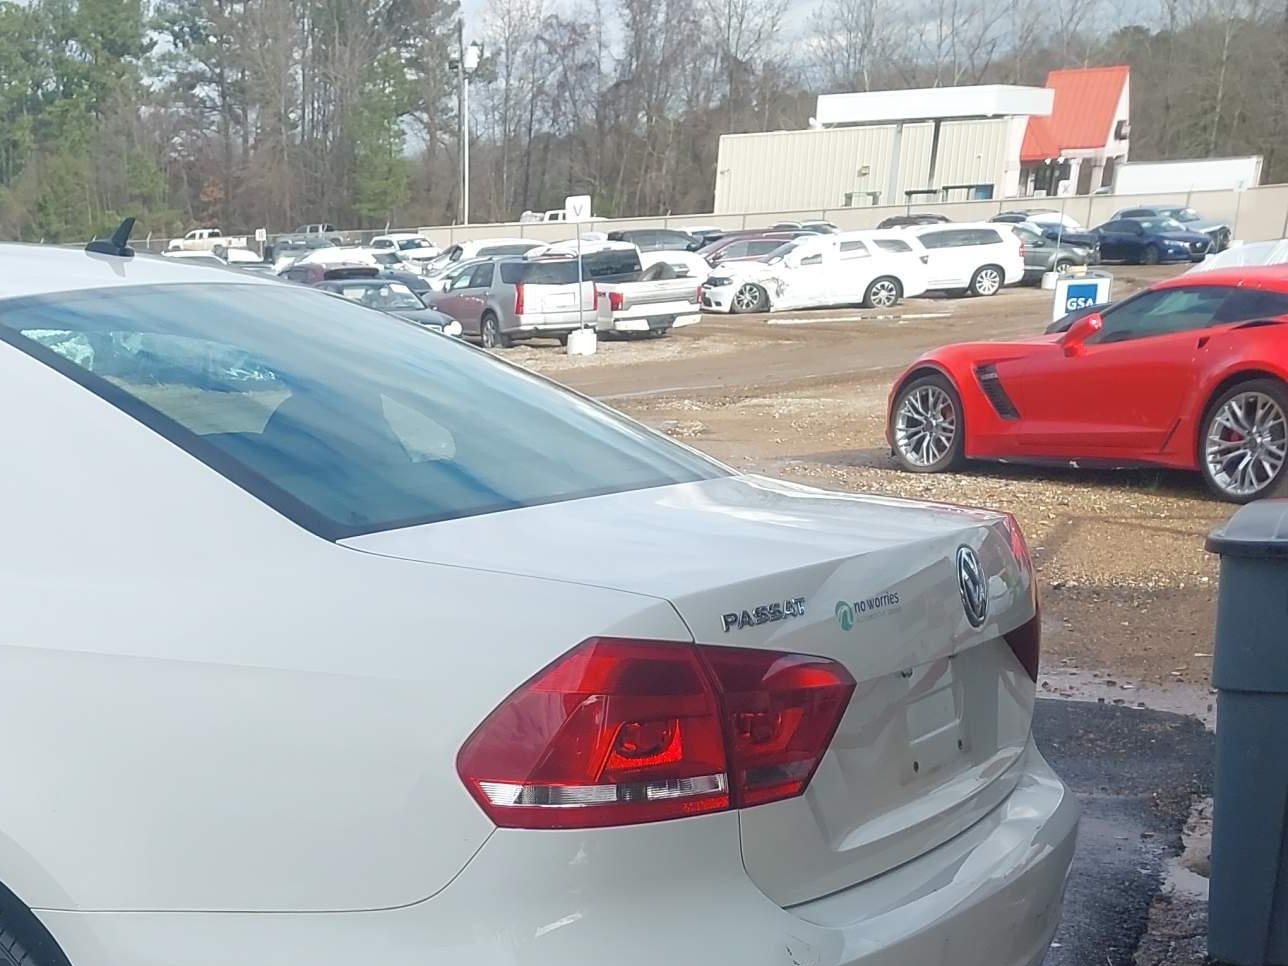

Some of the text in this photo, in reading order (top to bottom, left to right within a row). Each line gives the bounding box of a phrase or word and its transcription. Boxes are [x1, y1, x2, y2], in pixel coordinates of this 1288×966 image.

[1067, 297, 1094, 310] GSA
[854, 591, 900, 613] no worries
[720, 597, 805, 632] PASSAT
